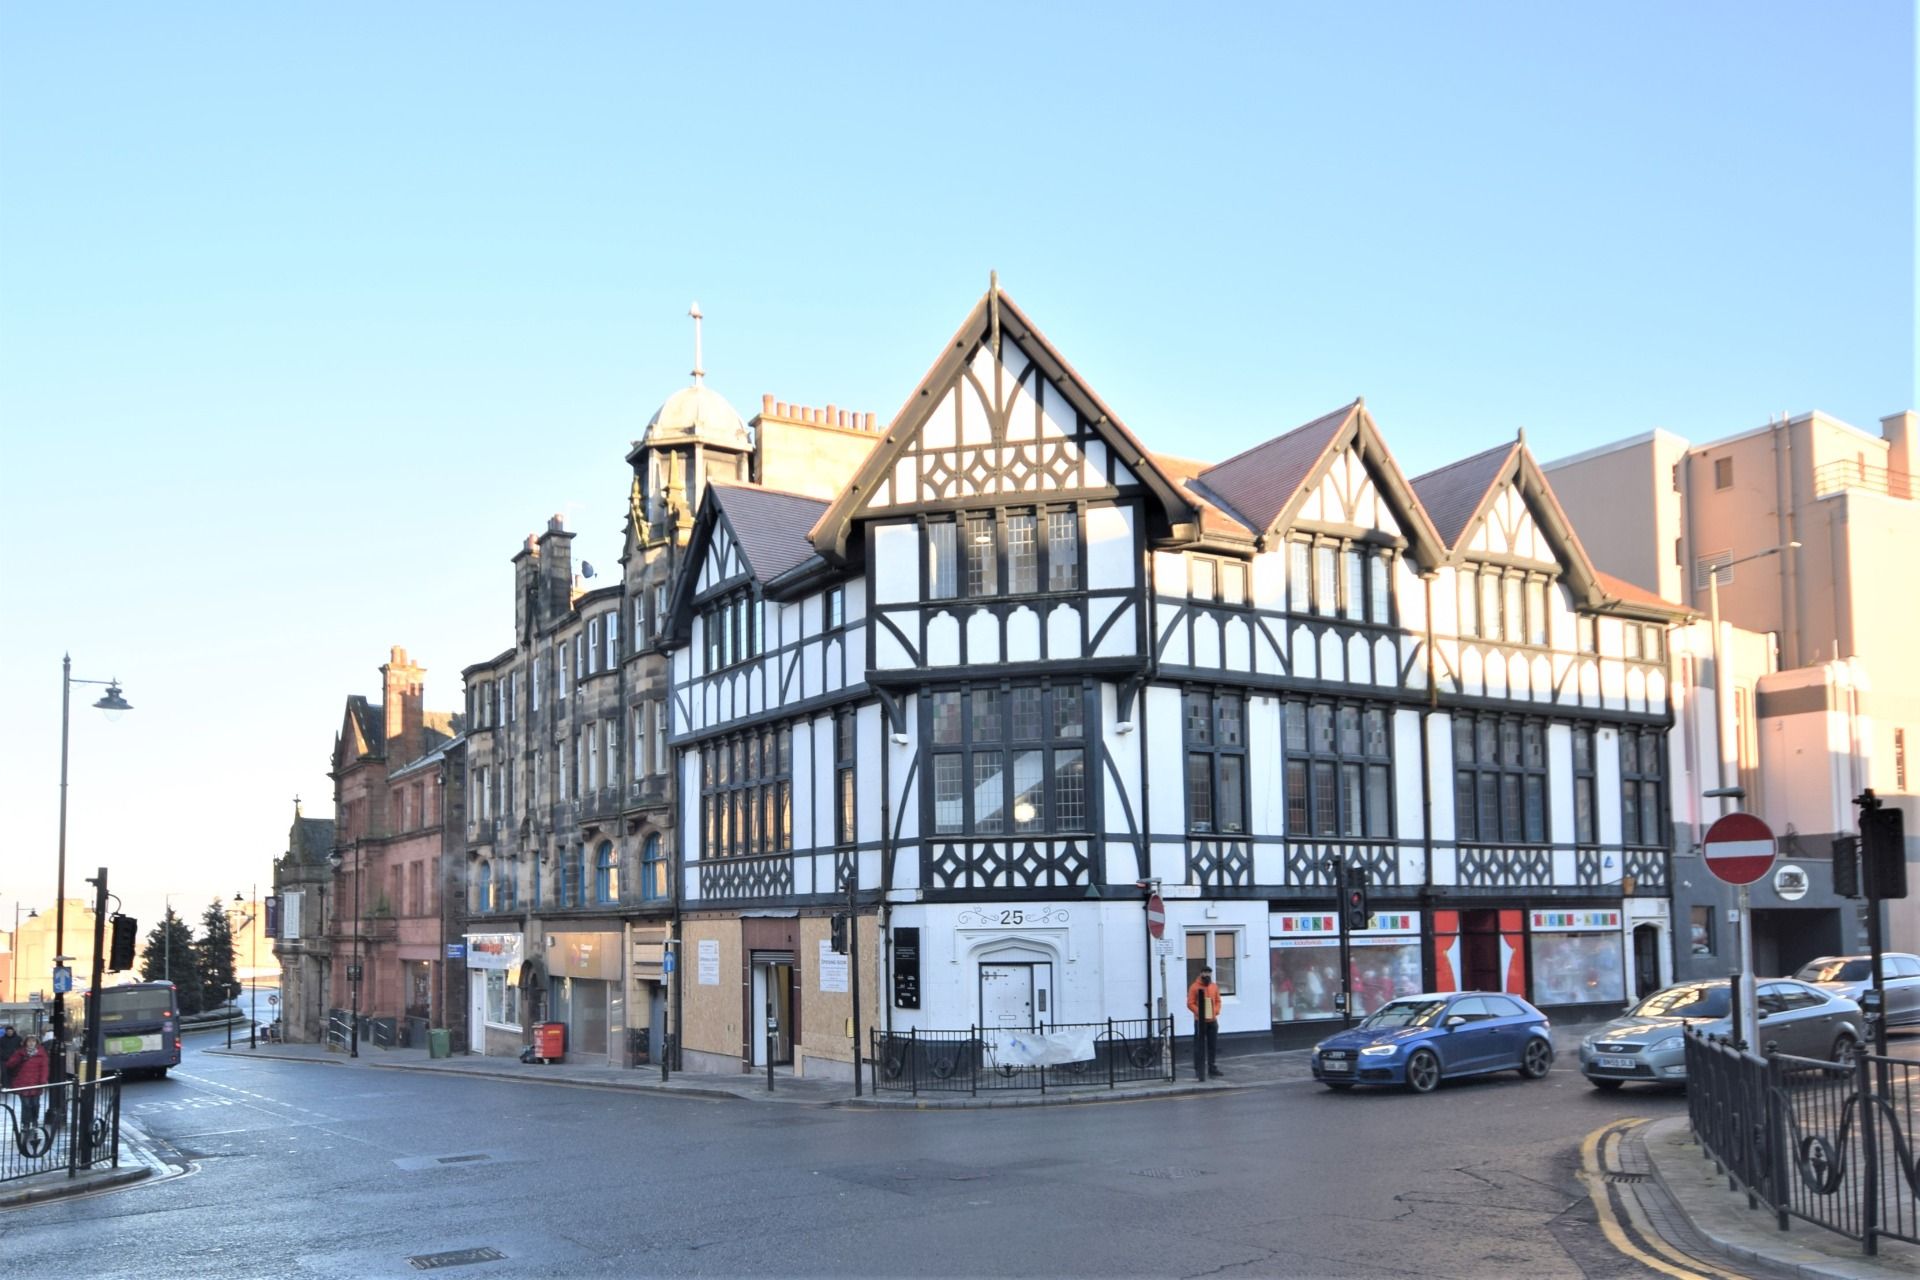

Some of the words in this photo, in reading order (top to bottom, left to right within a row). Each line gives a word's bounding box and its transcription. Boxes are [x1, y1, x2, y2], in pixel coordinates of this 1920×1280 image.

[1001, 910, 1023, 925] 25
[1283, 917, 1332, 930] KICKS
[1369, 916, 1409, 929] KIDS
[1535, 914, 1573, 926] KICKS
[1585, 913, 1616, 925] KIDS
